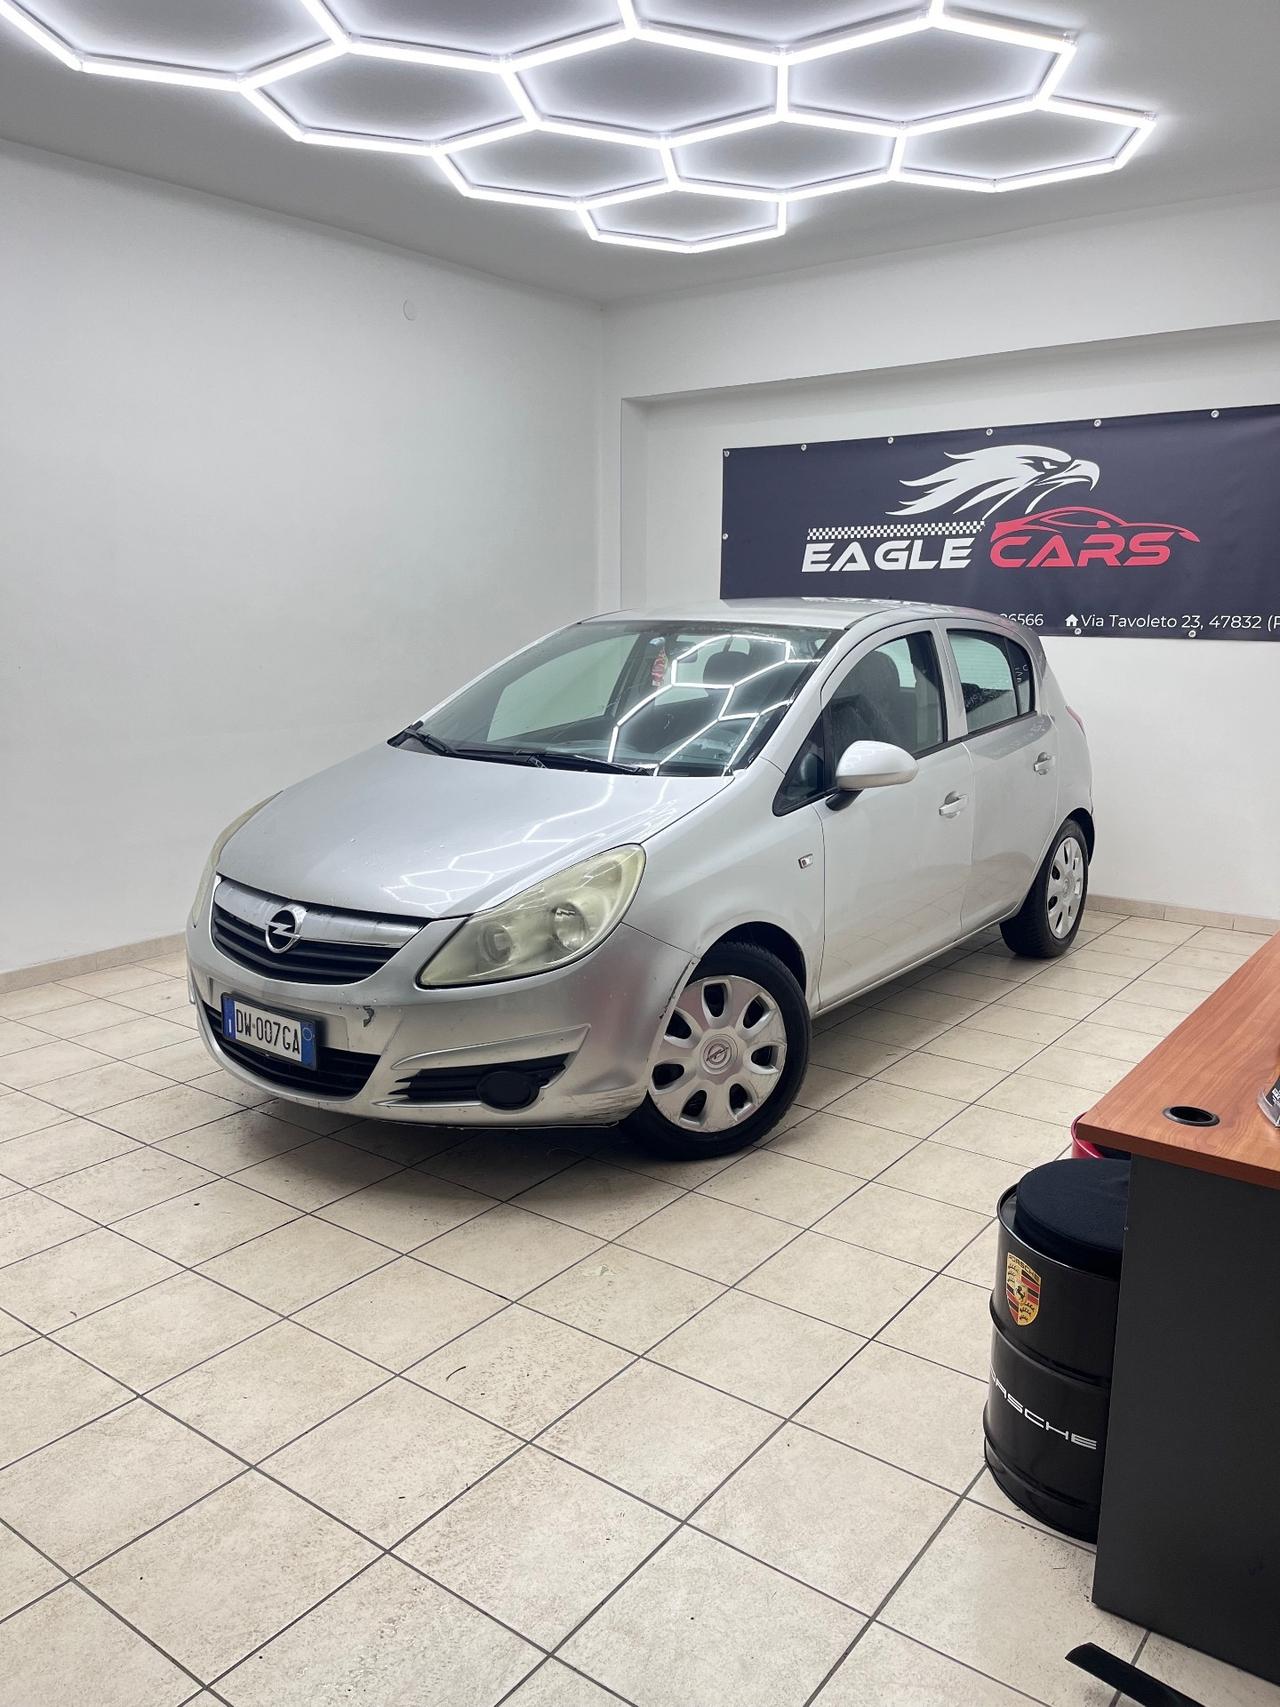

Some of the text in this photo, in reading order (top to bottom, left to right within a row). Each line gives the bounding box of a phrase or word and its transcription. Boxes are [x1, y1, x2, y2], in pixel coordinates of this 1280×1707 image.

[801, 531, 1175, 573] EAGLE CARS
[1080, 614, 1104, 627] Via
[1109, 614, 1177, 628] Tavoleto
[1181, 615, 1204, 630] 23,
[1208, 615, 1262, 629] 47832
